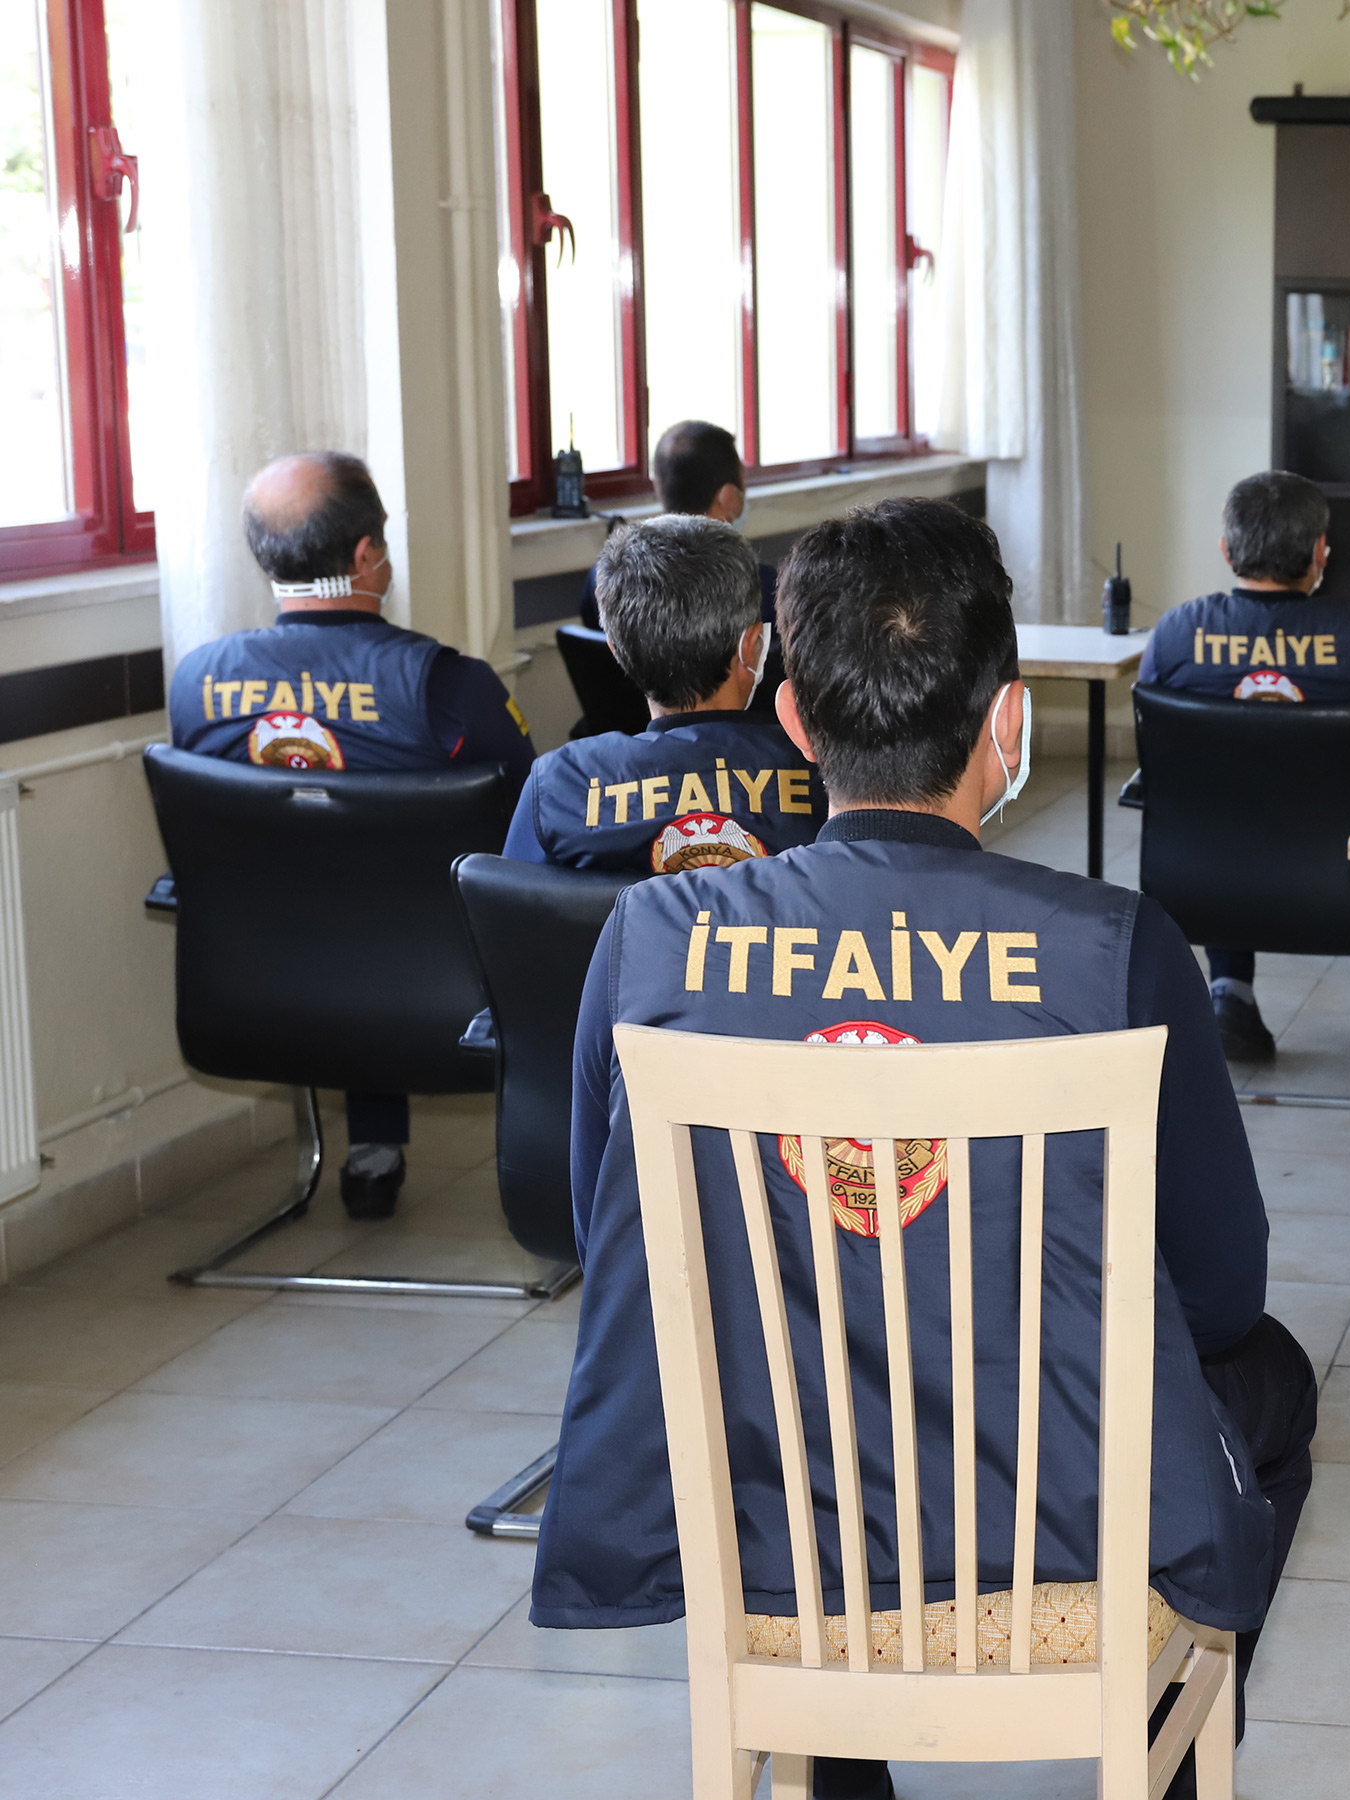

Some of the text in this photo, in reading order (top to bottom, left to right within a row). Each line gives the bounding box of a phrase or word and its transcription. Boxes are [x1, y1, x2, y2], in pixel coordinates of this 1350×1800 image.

[1194, 627, 1338, 666] İTFAİYE
[202, 671, 380, 721] İTFAİYE
[585, 757, 812, 827] İTFAİYE
[679, 846, 733, 860] KONYA
[685, 910, 1042, 1003] İTFAİYE
